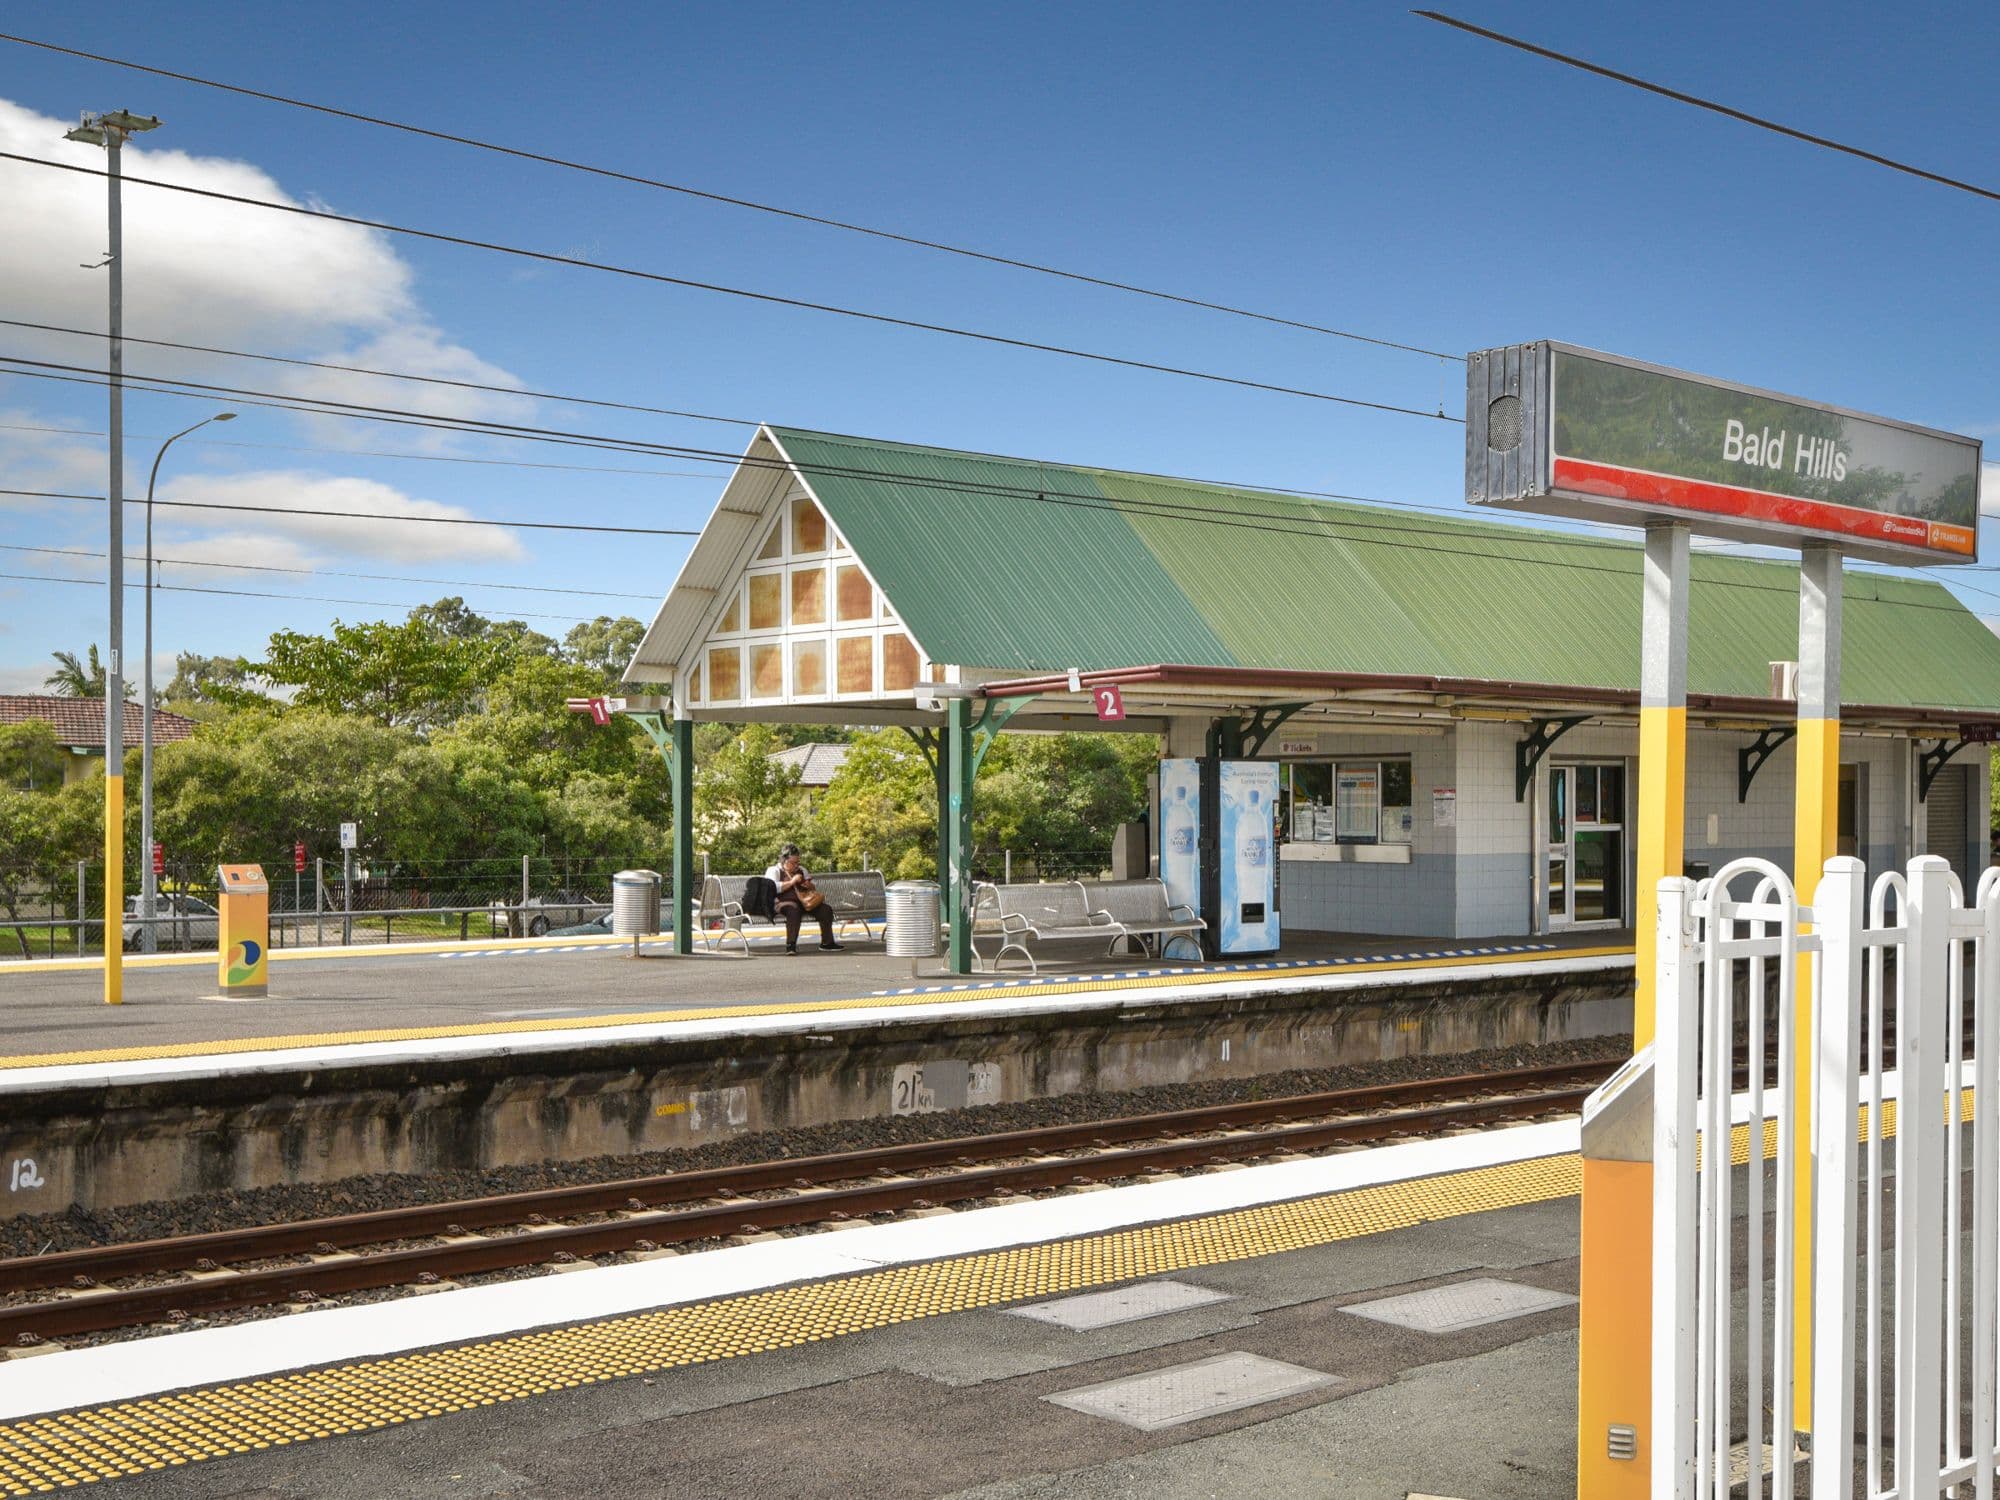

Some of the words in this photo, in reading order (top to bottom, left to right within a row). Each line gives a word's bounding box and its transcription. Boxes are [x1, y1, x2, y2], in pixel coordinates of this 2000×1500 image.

[1722, 419, 1786, 470] Bald
[1794, 433, 1847, 482] Hills
[594, 701, 605, 721] 1
[1100, 691, 1118, 716] 2
[1290, 743, 1312, 752] Tickets
[10, 1158, 45, 1192] 12
